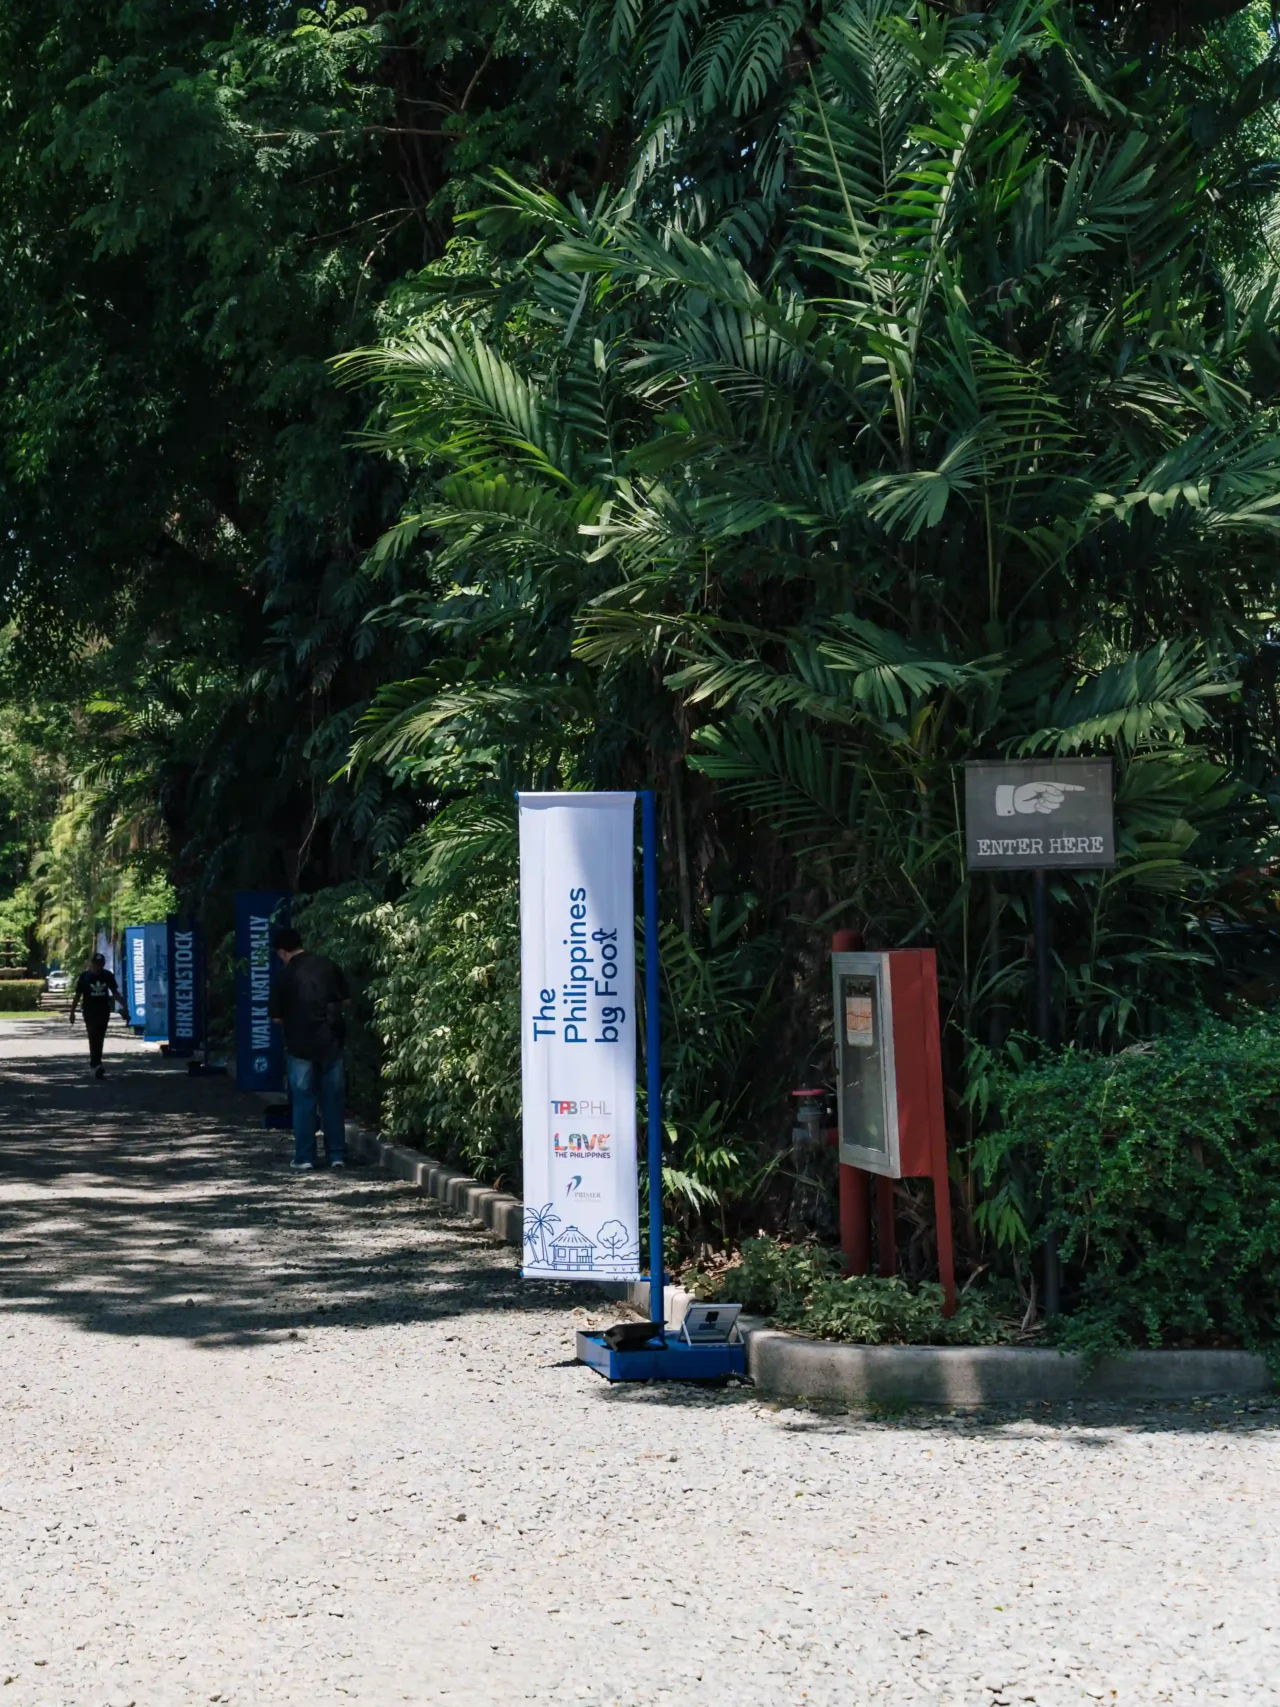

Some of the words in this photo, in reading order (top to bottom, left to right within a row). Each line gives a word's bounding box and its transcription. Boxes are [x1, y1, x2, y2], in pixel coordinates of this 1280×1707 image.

[977, 838, 1044, 856] ENTER
[1048, 836, 1104, 854] HERE
[133, 938, 145, 981] NATURALLY
[563, 887, 594, 1043] Philippines
[591, 928, 618, 996] Foot
[134, 982, 146, 1005] WALK
[174, 930, 194, 1038] BIRKENSTOCK
[251, 1008, 271, 1050] WALK
[532, 988, 556, 1042] The
[594, 1006, 626, 1043] by
[554, 1132, 611, 1151] LOVE
[569, 1151, 611, 1159] PHILIPPINES
